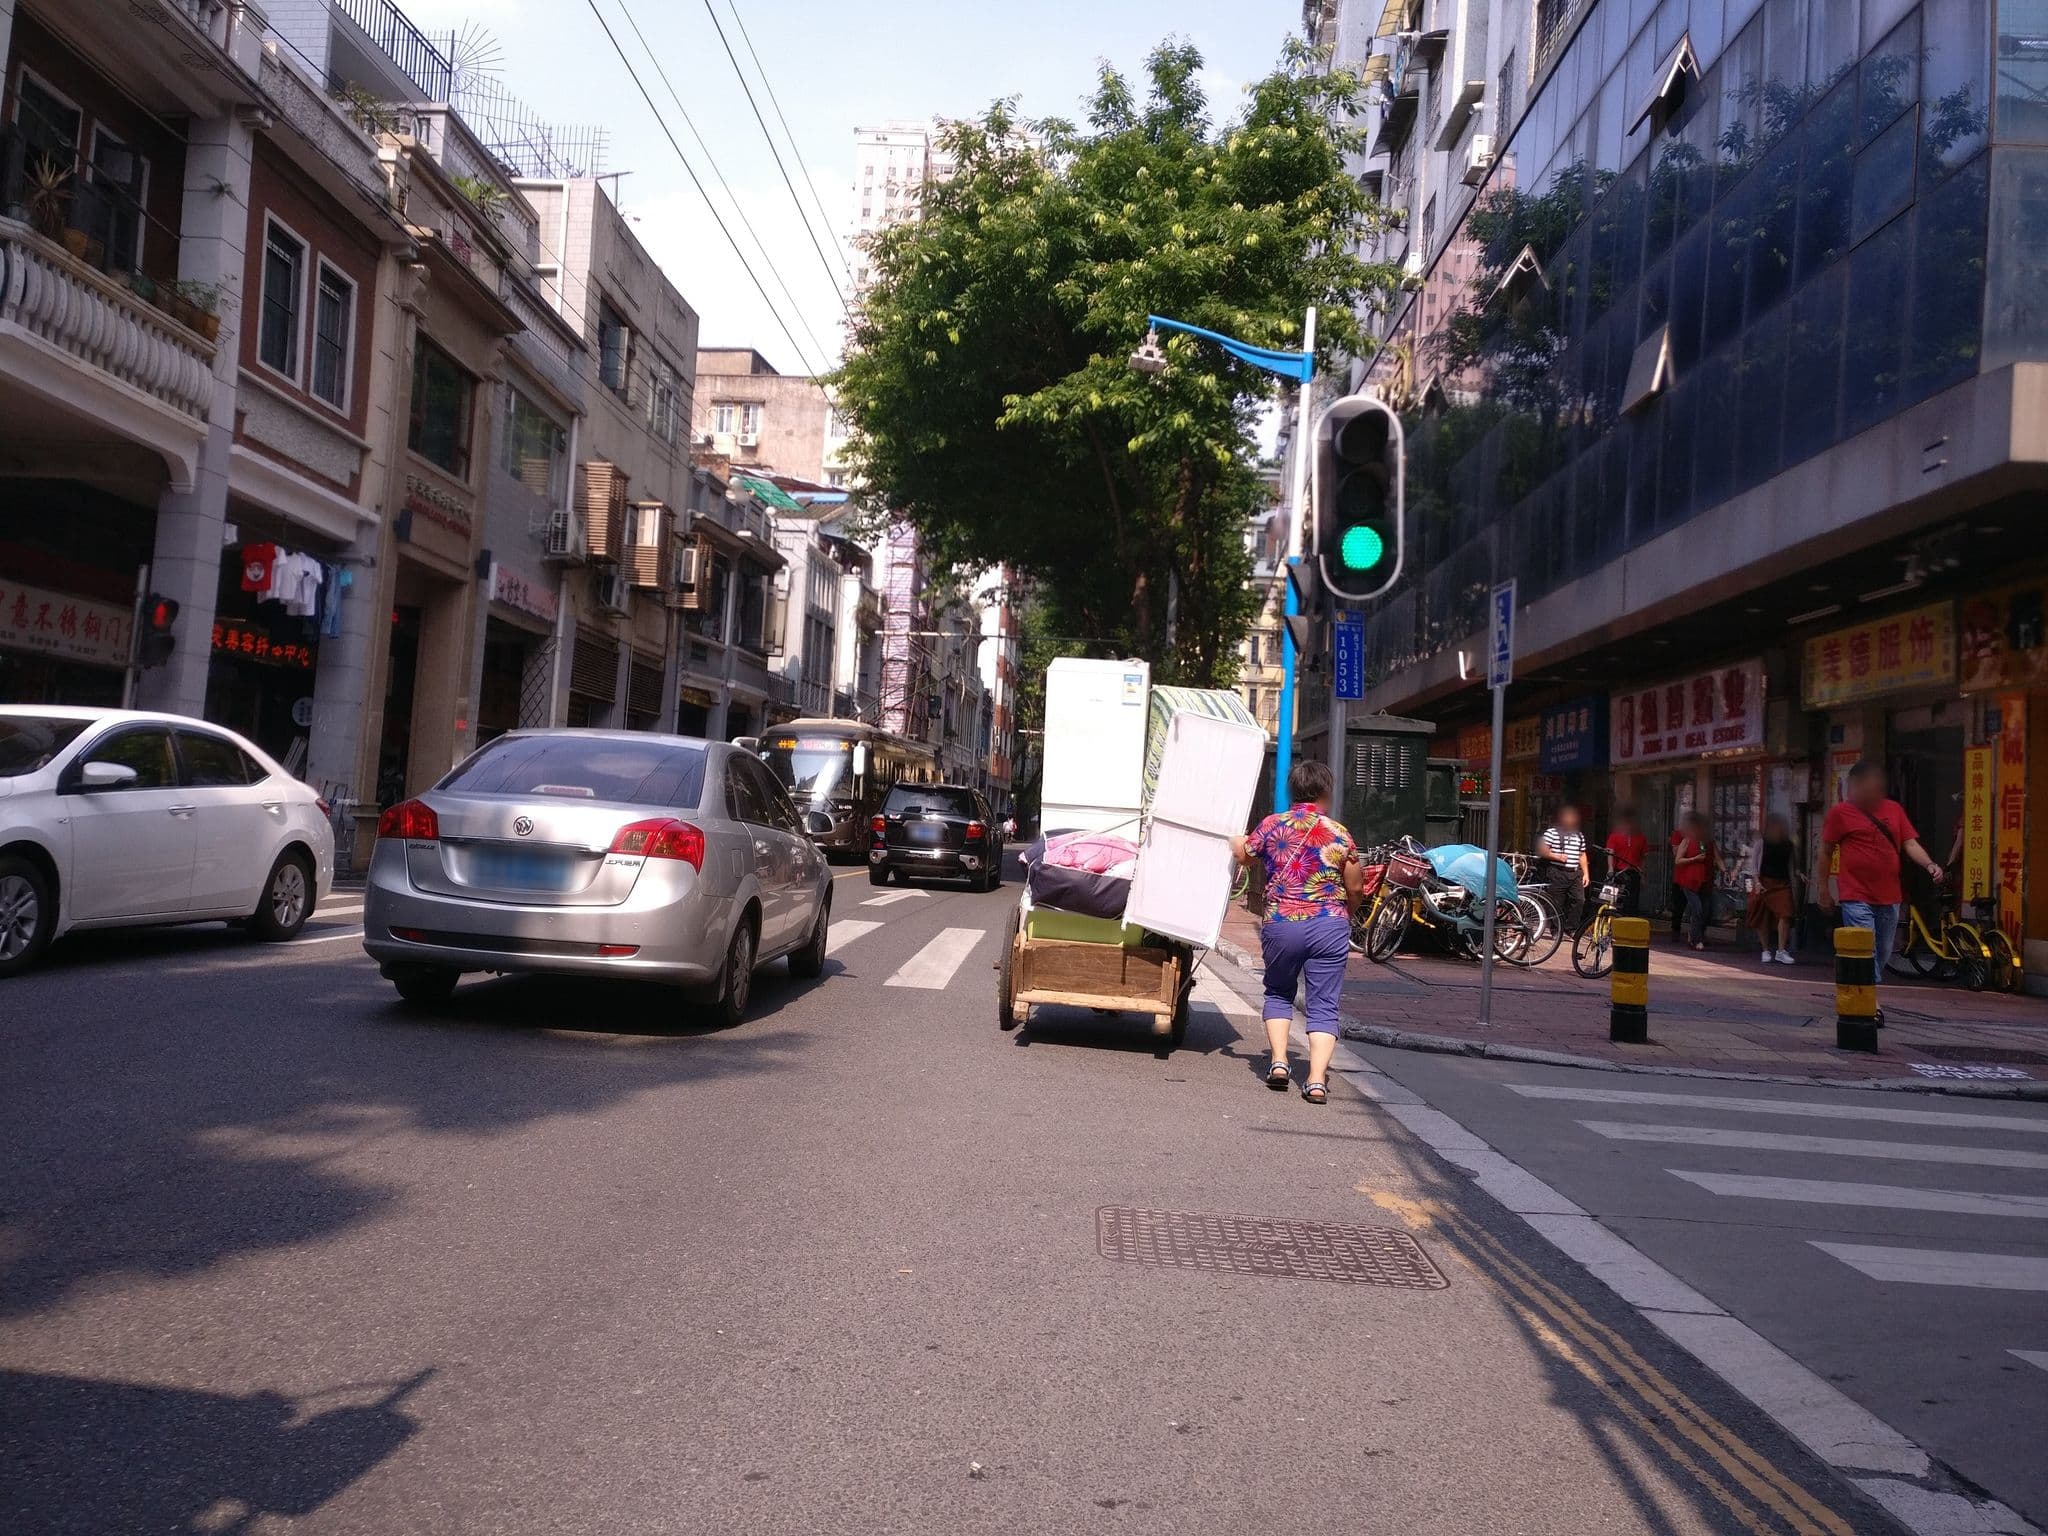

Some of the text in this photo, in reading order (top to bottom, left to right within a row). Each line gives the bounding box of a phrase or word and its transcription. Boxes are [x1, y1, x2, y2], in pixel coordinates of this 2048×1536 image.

[0, 590, 132, 648] 意不锈钢门
[1339, 636, 1348, 692] 1053
[1823, 615, 1935, 682] 美德服饰
[1685, 731, 1707, 748] REAL
[1712, 724, 1746, 744] ESTATE
